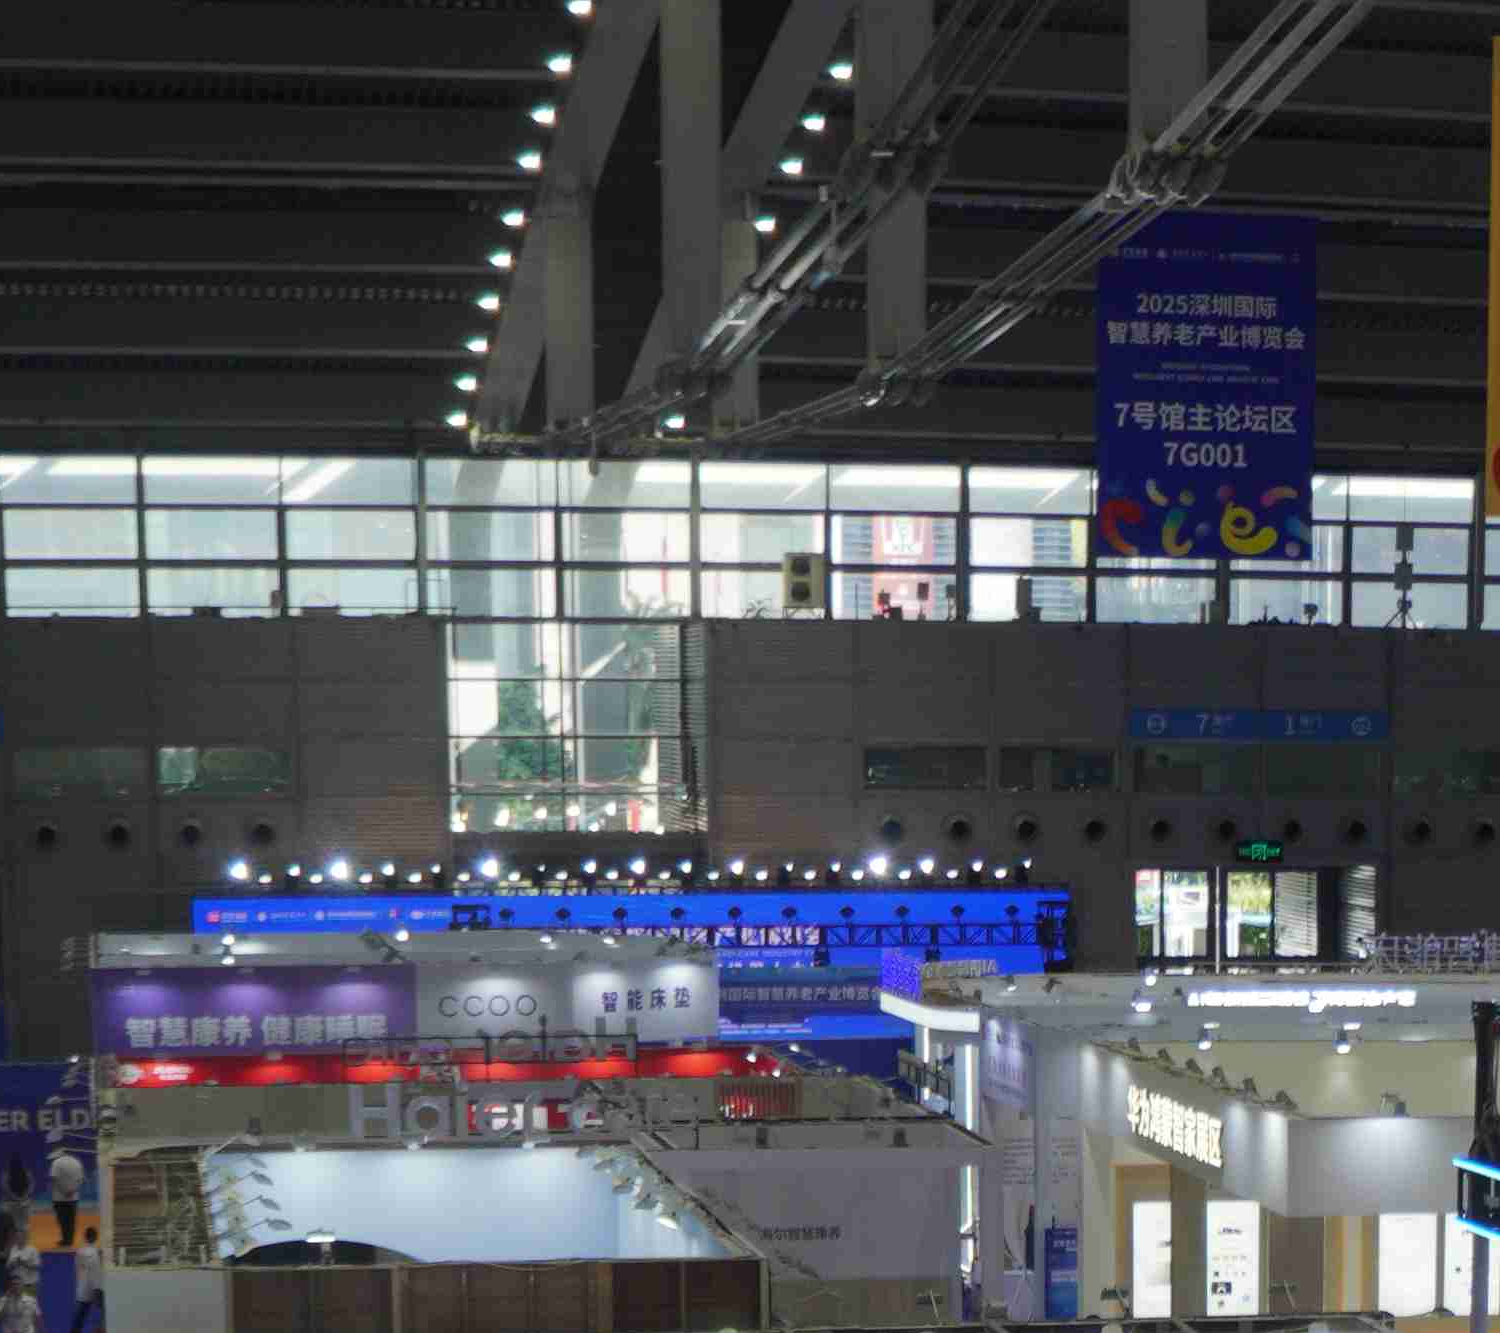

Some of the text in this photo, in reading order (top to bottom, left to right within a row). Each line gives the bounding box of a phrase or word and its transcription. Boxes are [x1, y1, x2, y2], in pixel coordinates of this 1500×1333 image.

[1136, 293, 1278, 320] 2025深圳国际
[1106, 320, 1307, 351] 智慧养老产业博览会
[1113, 401, 1298, 435] 7号馆主论坛区
[1163, 442, 1248, 469] 7G001
[601, 986, 693, 1014] 智能床垫
[125, 1016, 253, 1049] 智慧康养
